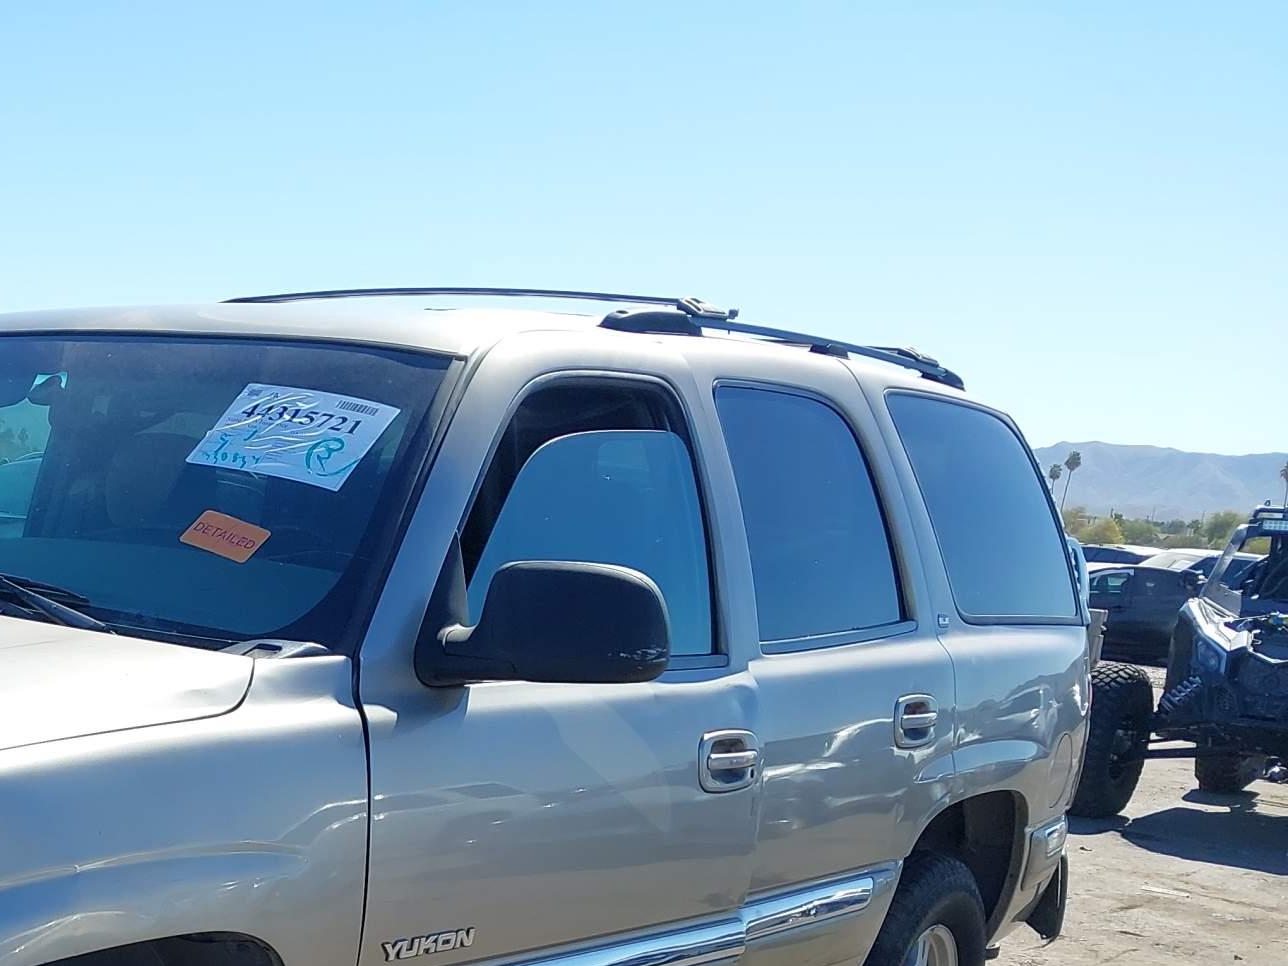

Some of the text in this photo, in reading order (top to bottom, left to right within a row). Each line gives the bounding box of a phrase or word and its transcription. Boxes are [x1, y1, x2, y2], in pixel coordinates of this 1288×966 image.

[241, 402, 363, 435] 44315721
[193, 521, 256, 549] DETAILED
[382, 927, 476, 961] YUKON
